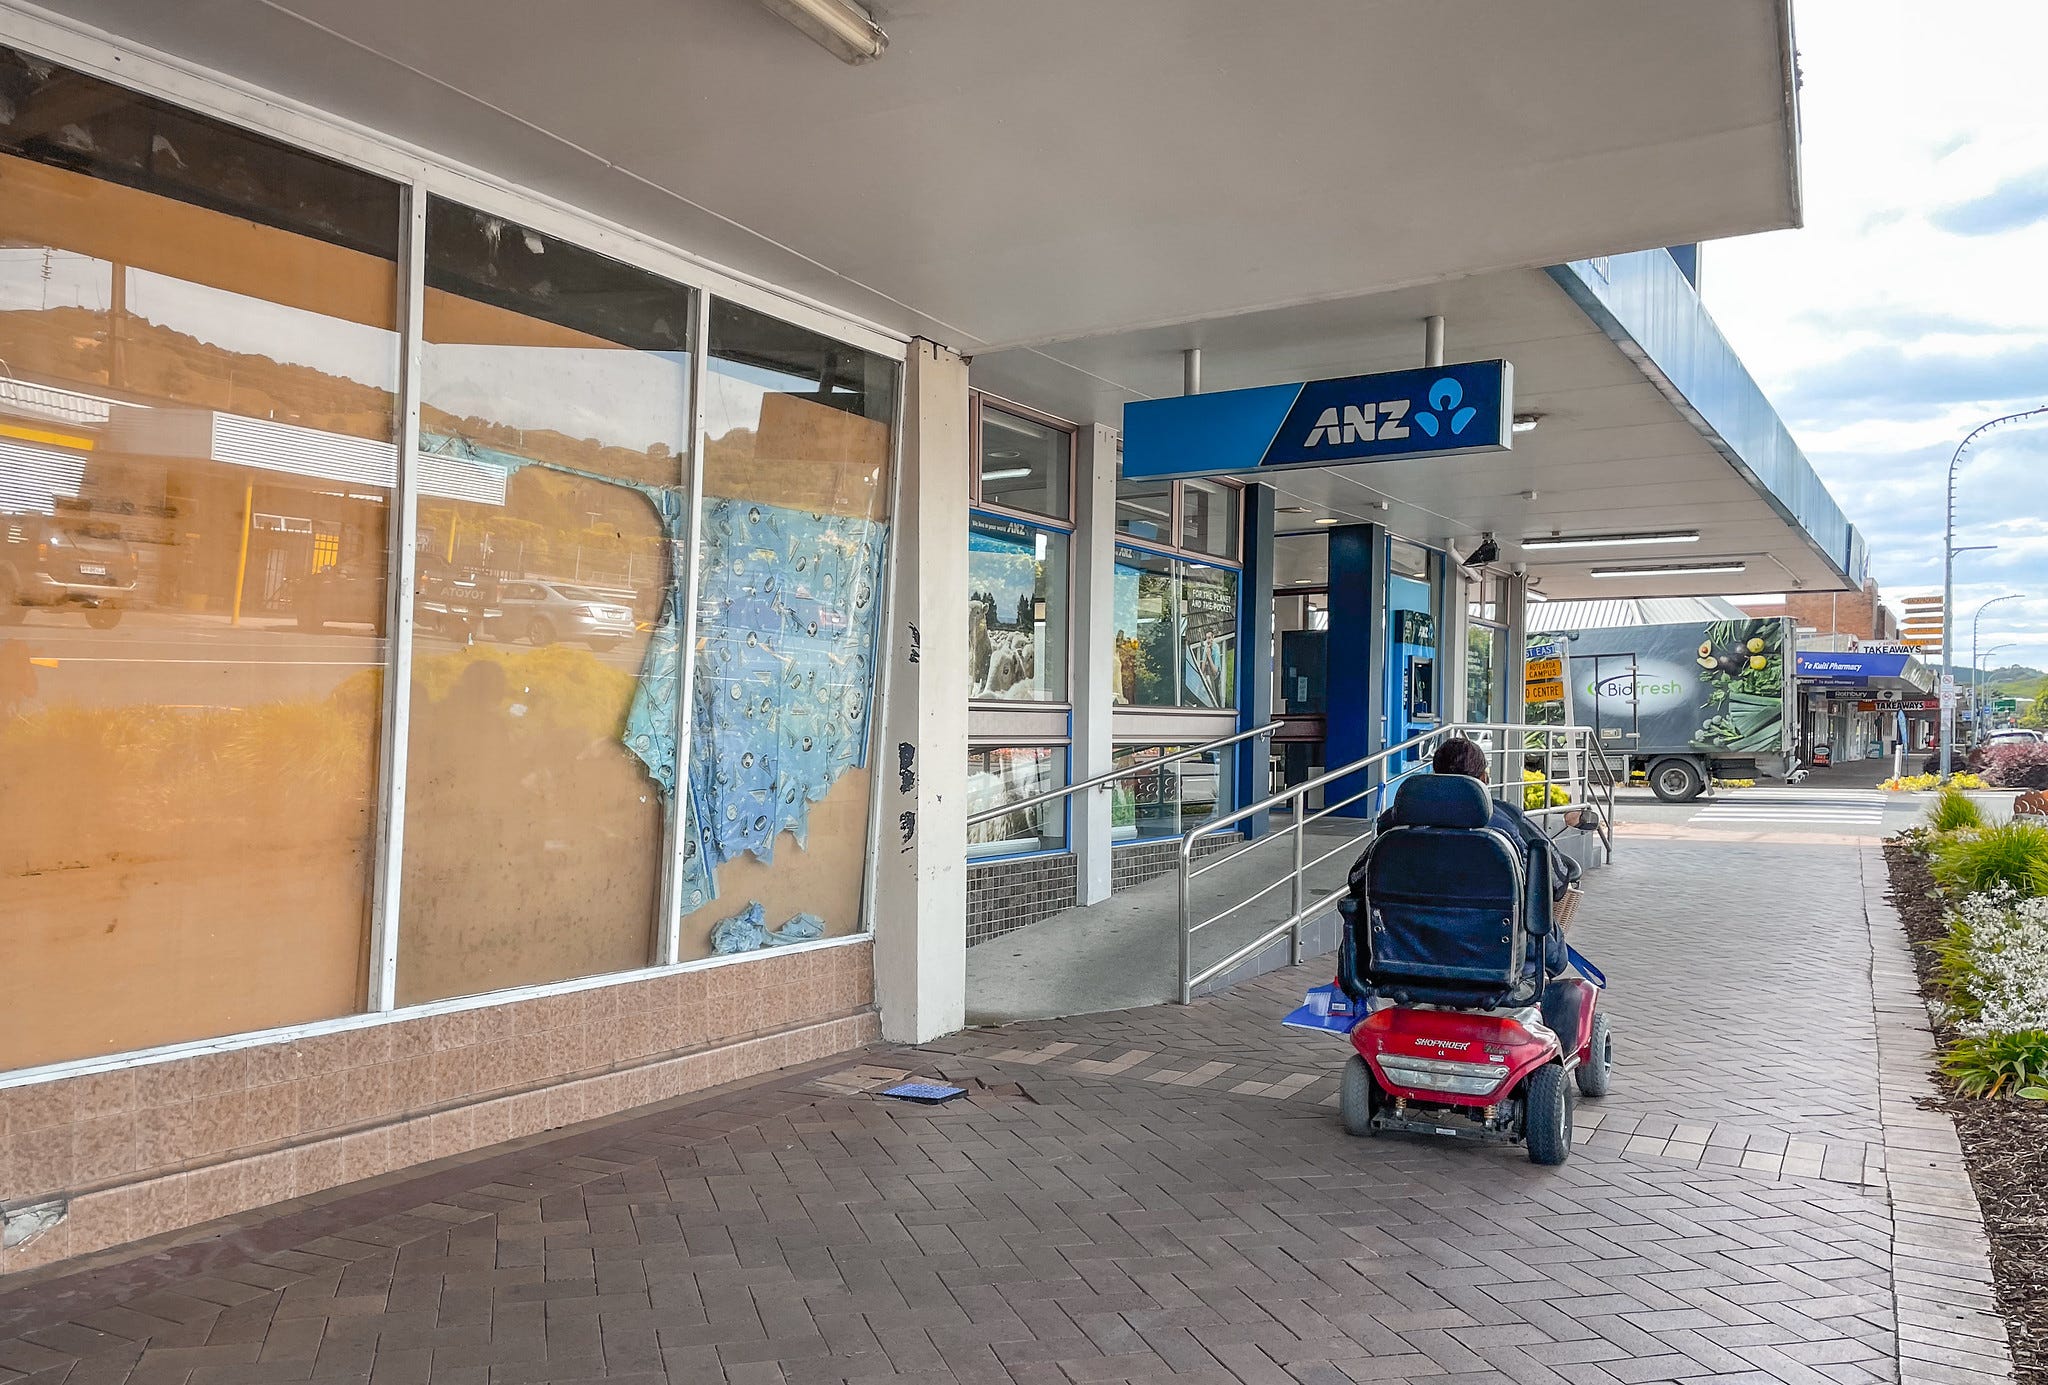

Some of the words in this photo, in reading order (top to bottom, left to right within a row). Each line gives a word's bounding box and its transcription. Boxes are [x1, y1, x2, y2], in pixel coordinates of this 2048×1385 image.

[1303, 400, 1410, 447] ANZ
[1007, 522, 1026, 535] ANZ
[1118, 547, 1133, 559] ANZ
[1192, 589, 1203, 598] FOR
[1203, 591, 1213, 600] THE
[1213, 593, 1231, 604] PLANET
[1192, 599, 1202, 608] AND
[1202, 601, 1213, 610] THE
[1213, 603, 1231, 613] POCKET
[1536, 645, 1556, 656] EAST
[1864, 645, 1922, 654] TAKEAWAYS
[1529, 661, 1556, 671] AOTEAROA
[1804, 661, 1813, 670] Te
[1812, 661, 1830, 670] Kuiti
[1829, 662, 1862, 672] Pharmacy
[1529, 668, 1557, 679] CAMPUS
[1533, 685, 1560, 698] CENTRE
[1608, 680, 1682, 697] Bidfresh
[1834, 690, 1868, 698] Rothbury
[1876, 701, 1924, 710] TAKEAWAYS
[1415, 1038, 1471, 1051] SHOPRIDER
